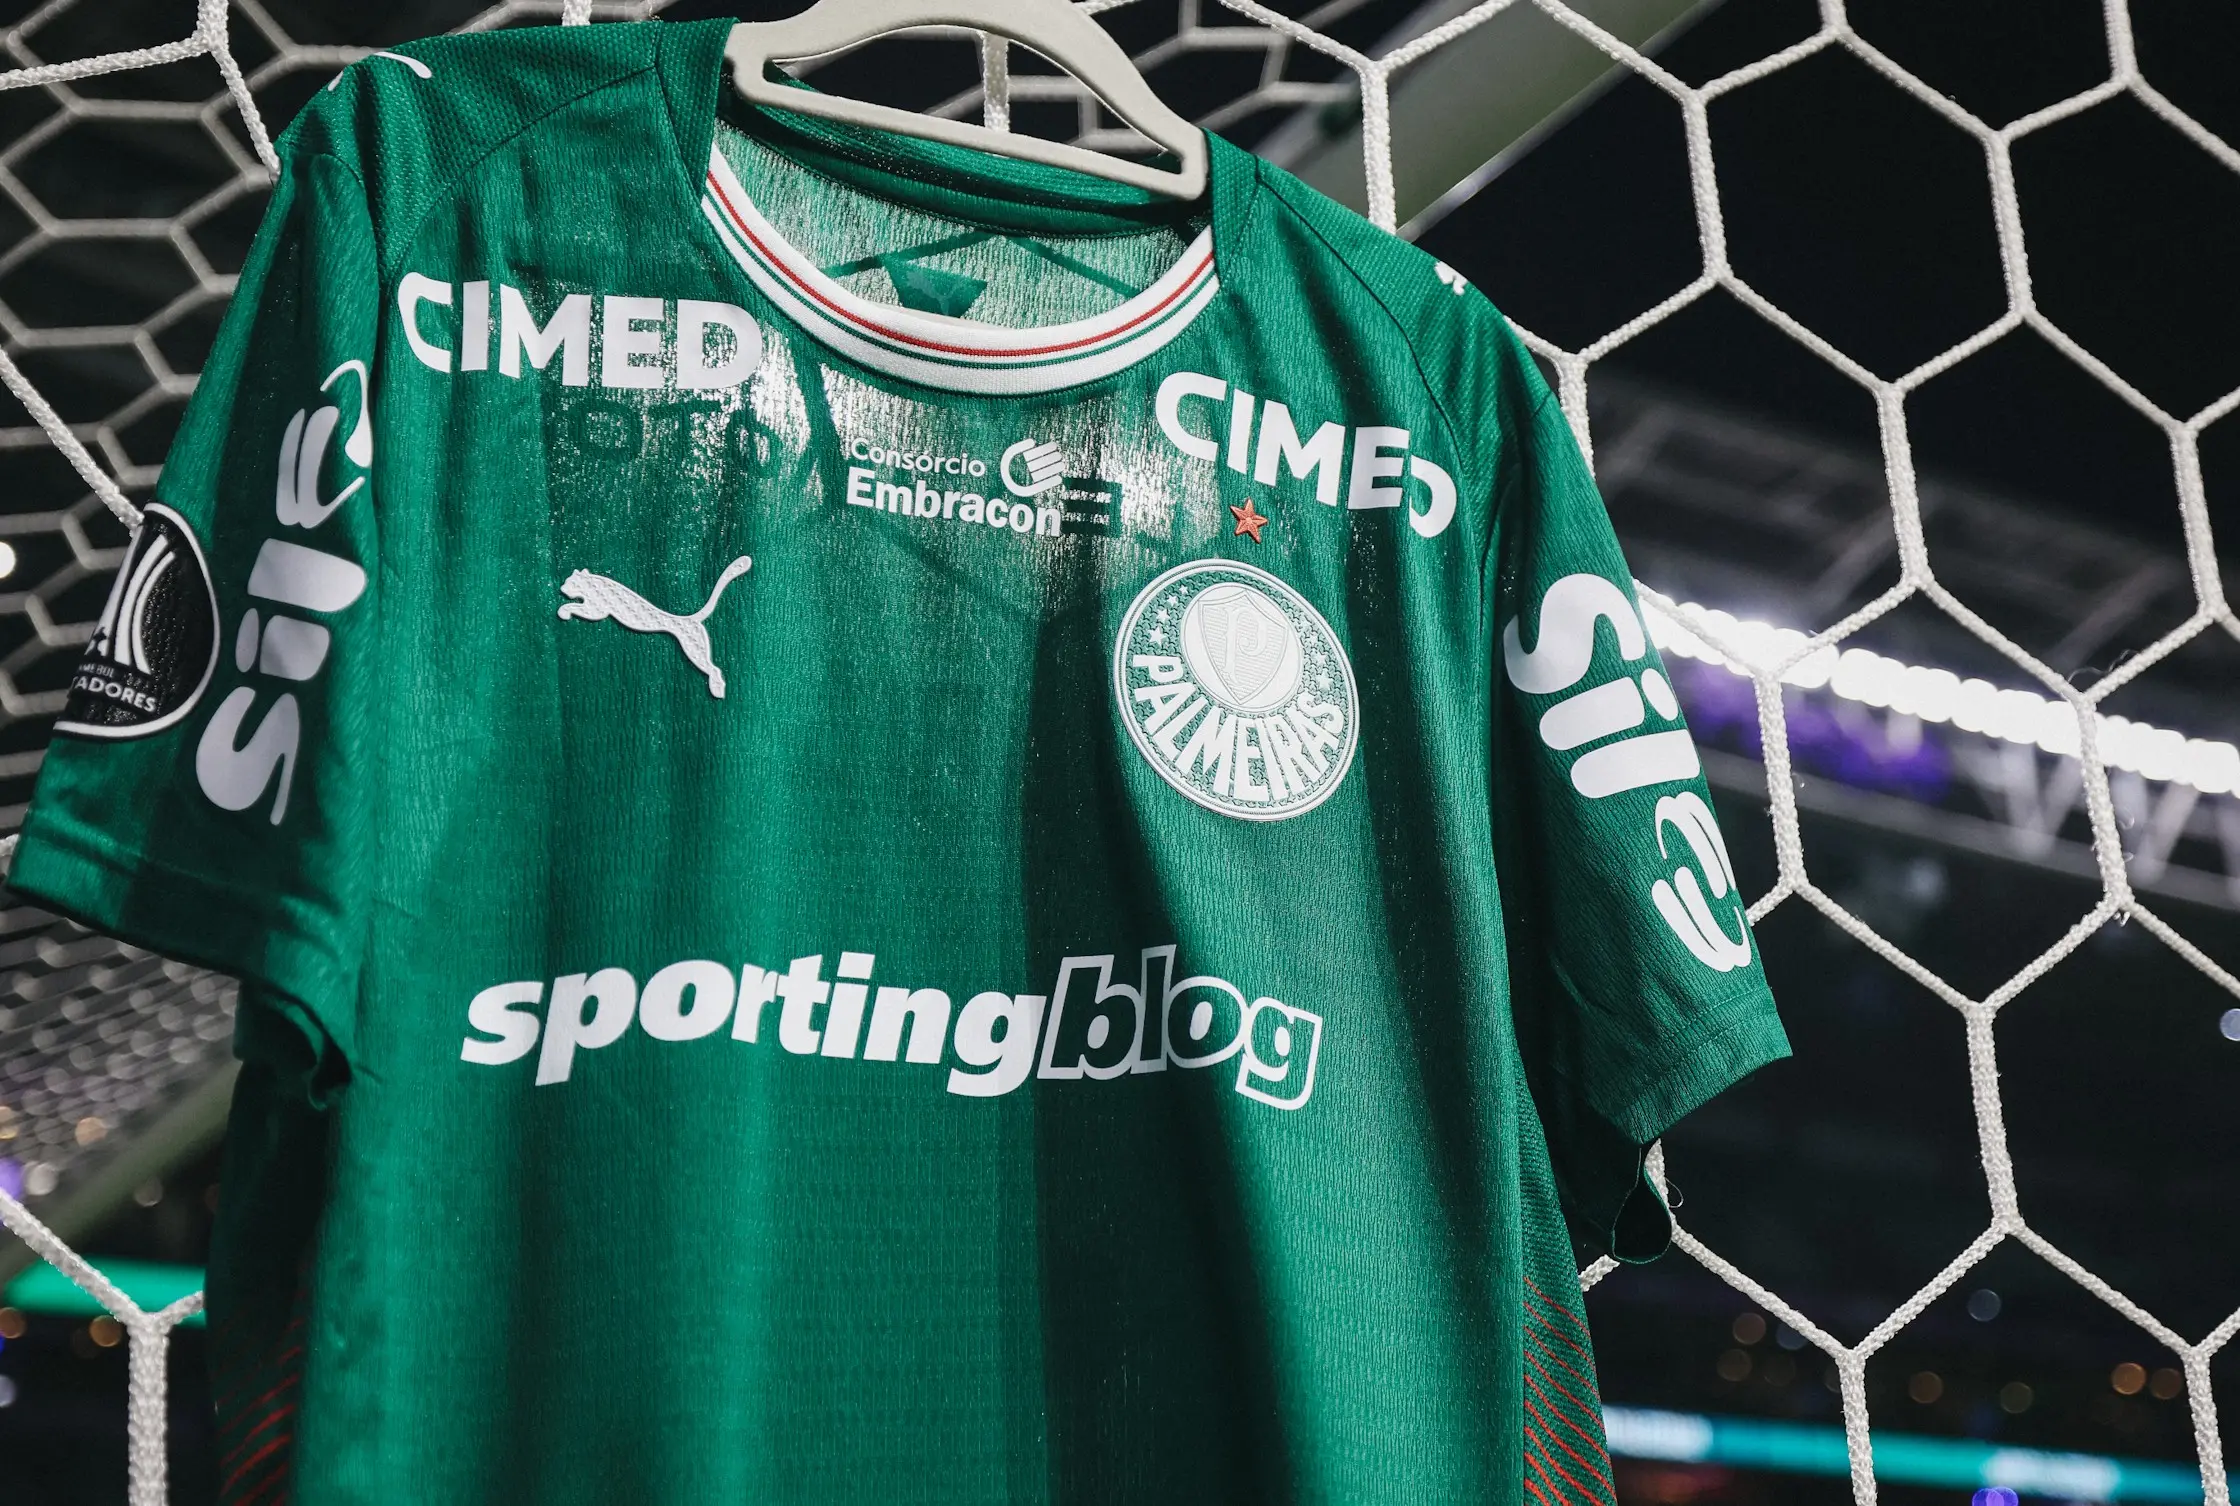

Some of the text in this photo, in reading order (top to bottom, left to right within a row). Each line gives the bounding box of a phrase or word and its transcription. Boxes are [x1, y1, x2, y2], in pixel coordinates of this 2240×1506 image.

[397, 271, 763, 390] CIMED
[846, 466, 1062, 538] Embracon
[850, 436, 986, 478] Consórcio
[1154, 371, 1457, 539] CIMED
[1132, 654, 1346, 802] PALMEIRAS
